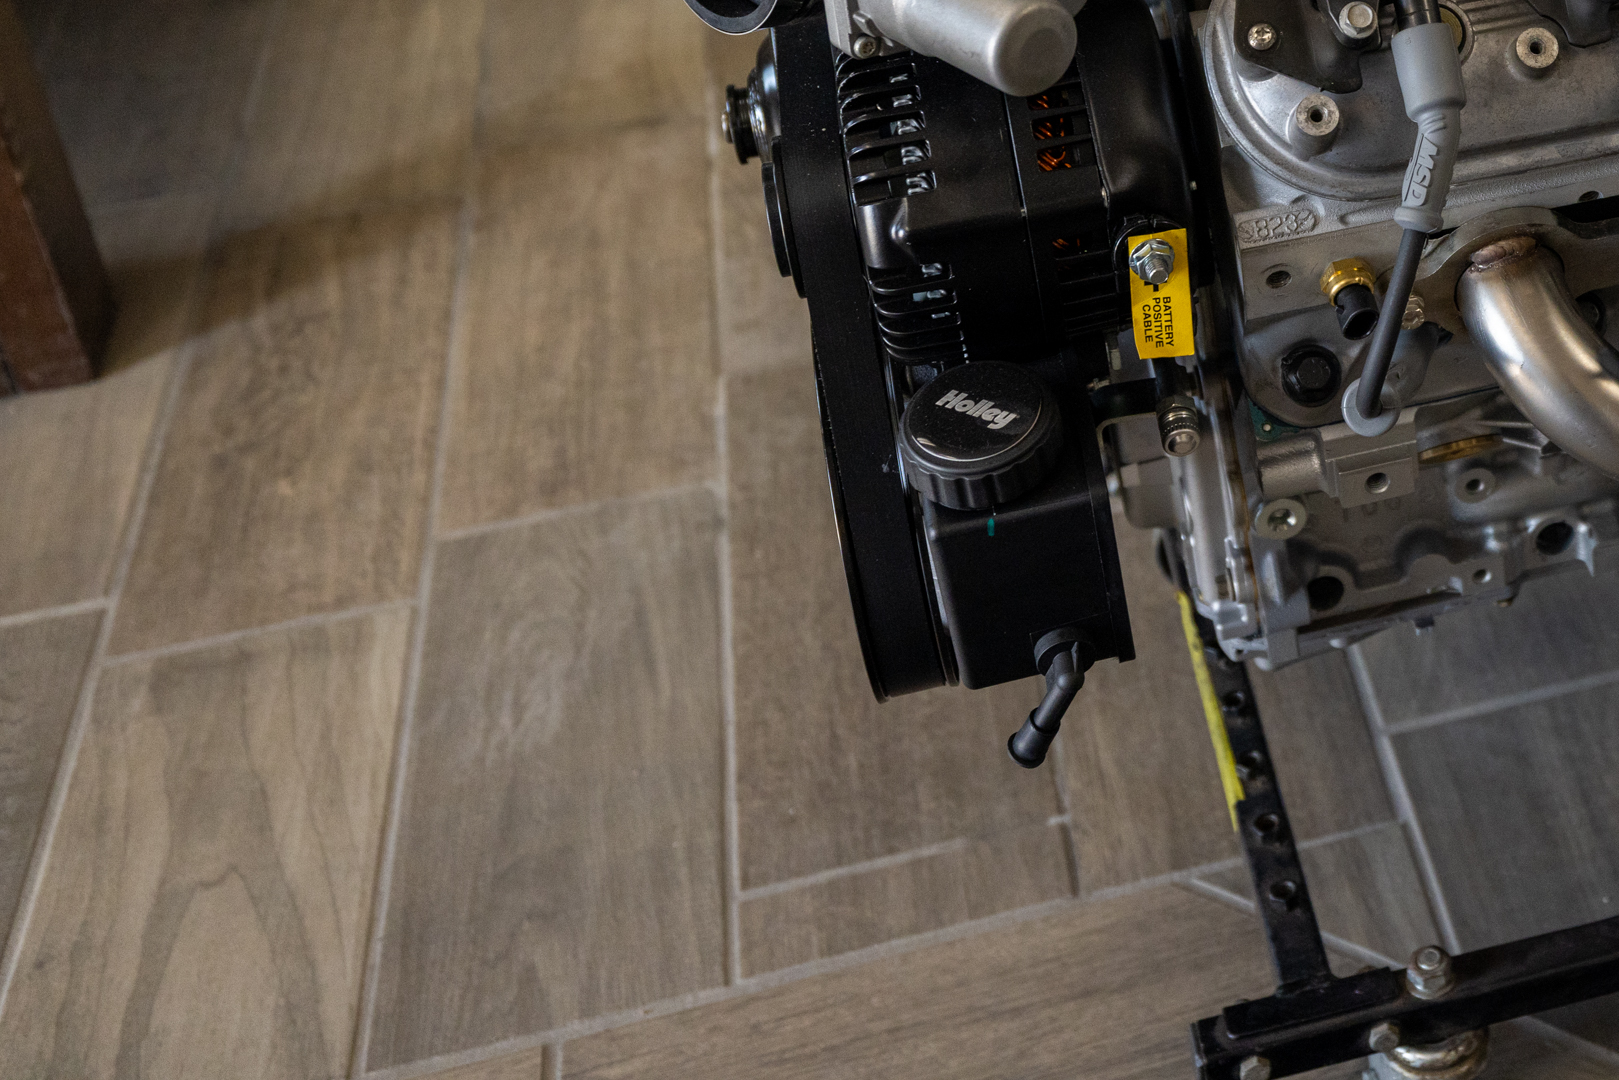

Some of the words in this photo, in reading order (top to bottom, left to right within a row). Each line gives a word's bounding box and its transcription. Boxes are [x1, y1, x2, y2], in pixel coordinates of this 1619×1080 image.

[1405, 134, 1439, 208] MSD
[1142, 304, 1153, 343] CABLE
[1152, 297, 1164, 348] POSITIVE
[1163, 296, 1174, 347] BATTERY
[935, 388, 1018, 431] Holley
